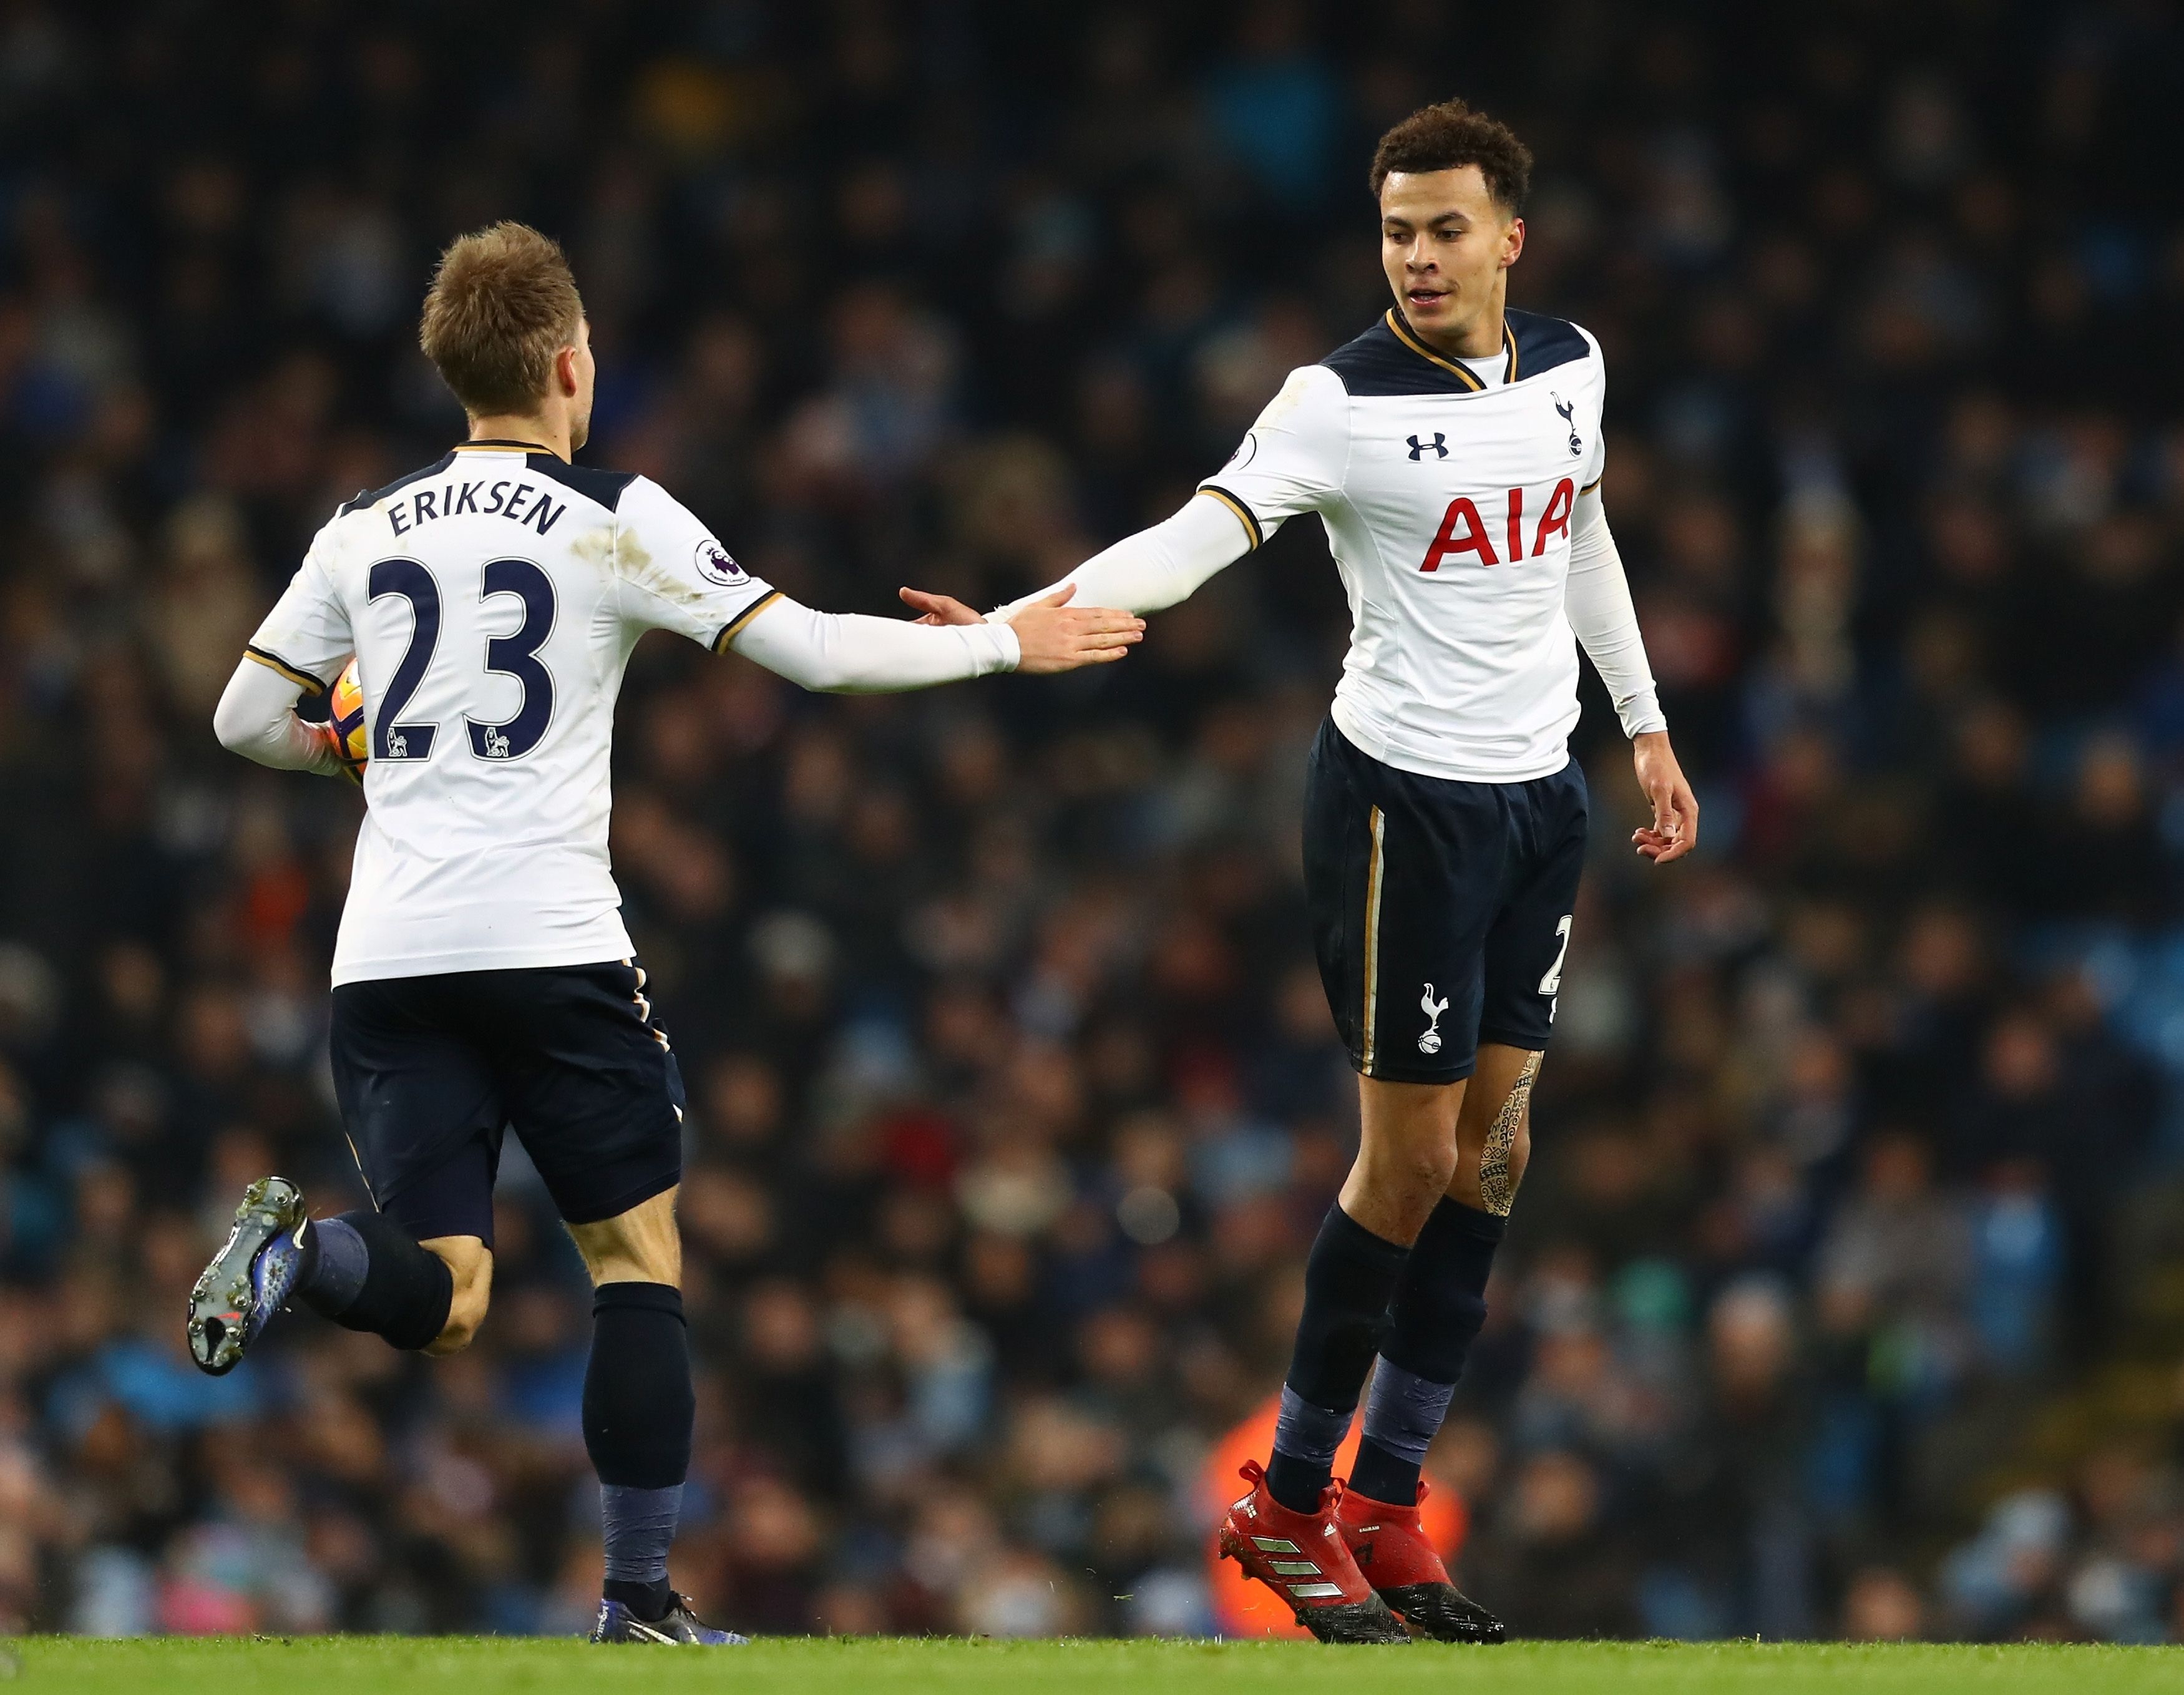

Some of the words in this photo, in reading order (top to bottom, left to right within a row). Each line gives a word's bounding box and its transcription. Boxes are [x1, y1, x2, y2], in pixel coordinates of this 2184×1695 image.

[388, 481, 566, 536] ERIKSEN
[1420, 478, 1574, 572] AIA
[366, 557, 558, 762] 23
